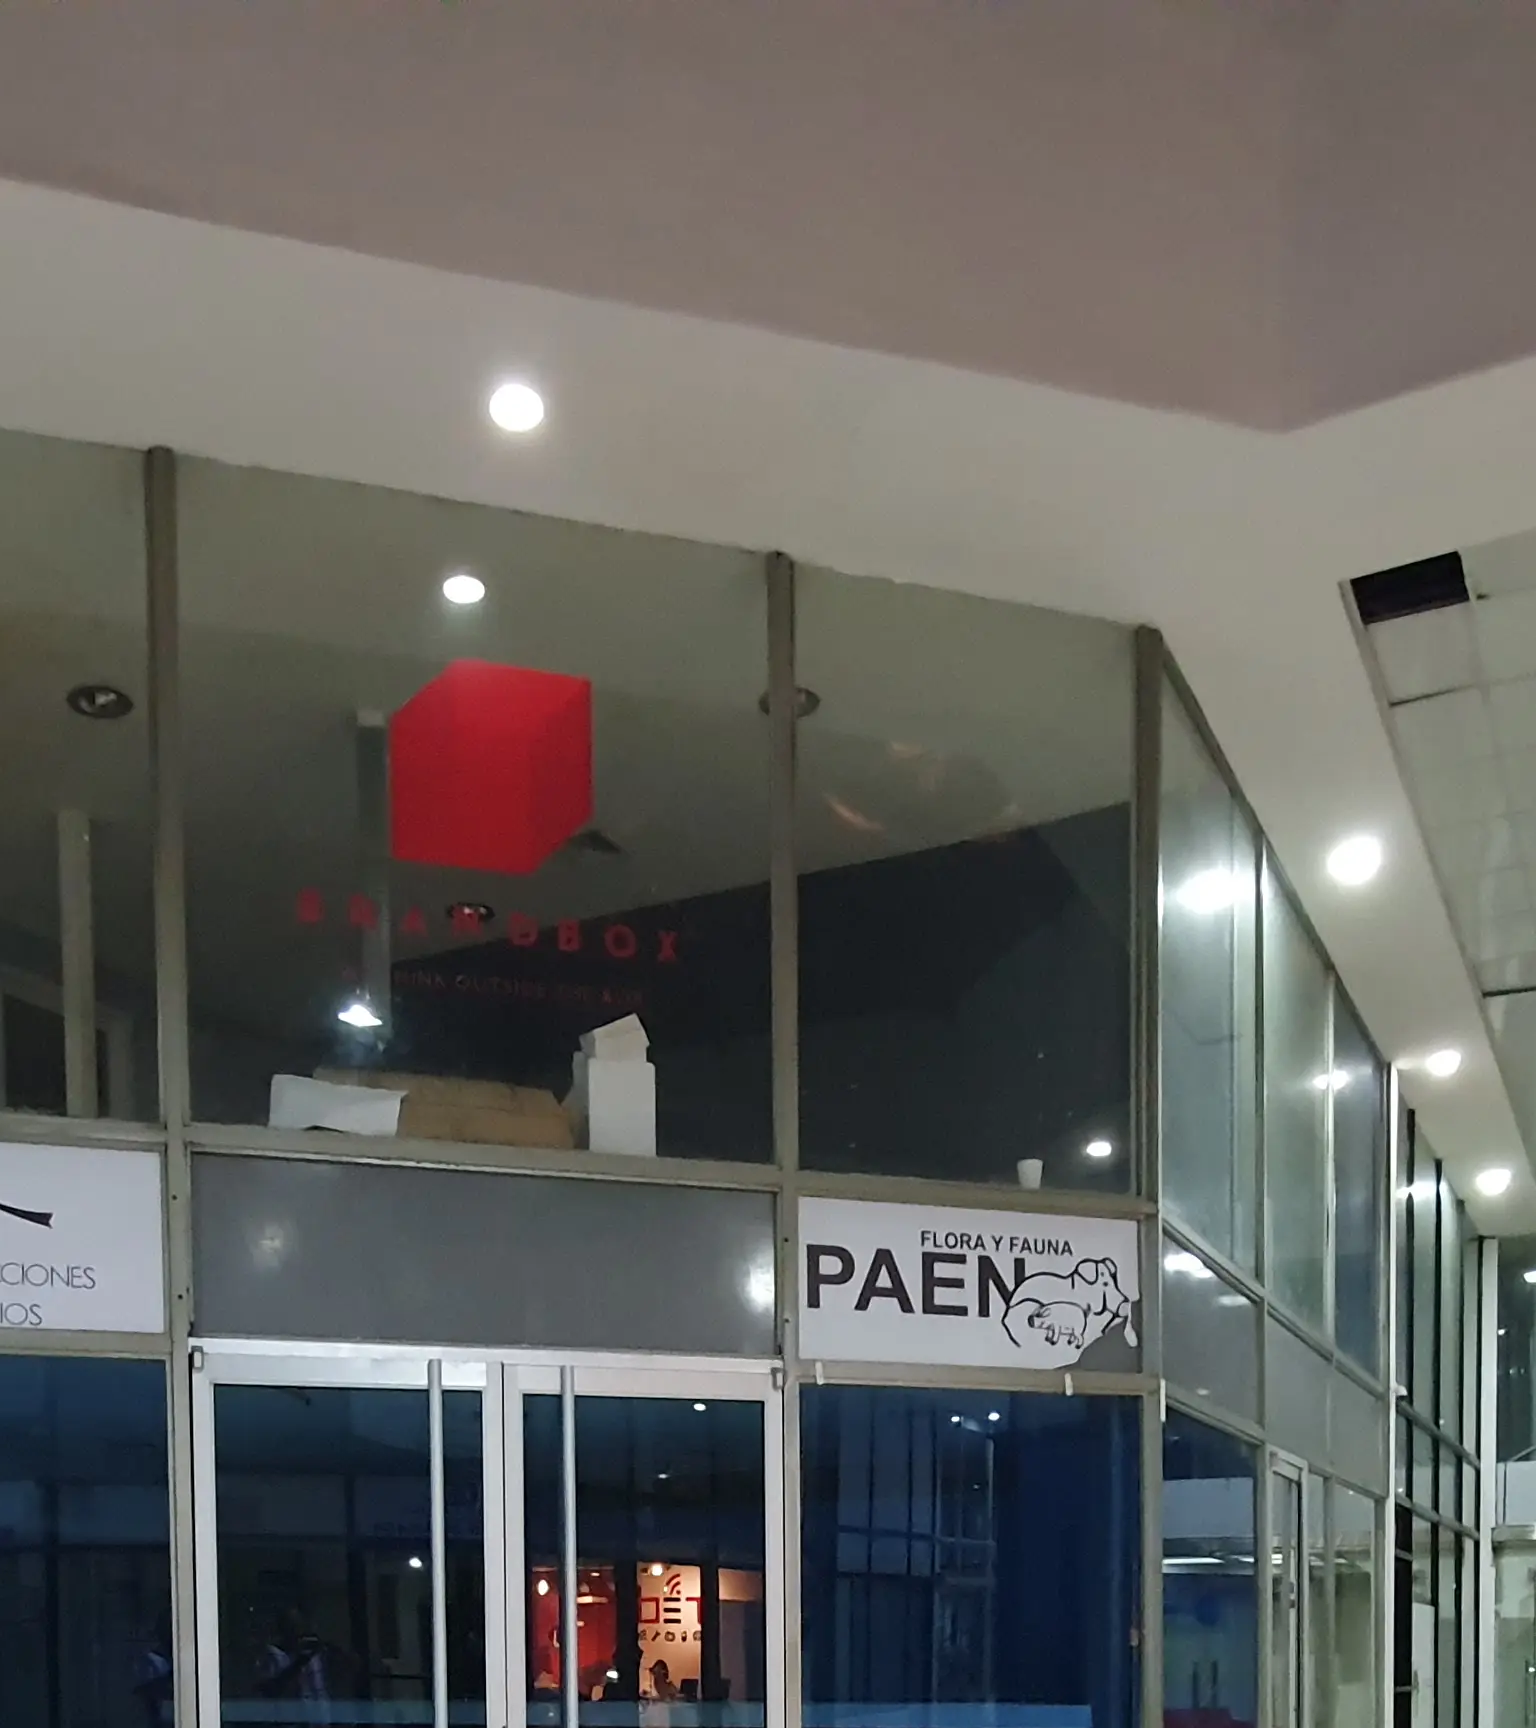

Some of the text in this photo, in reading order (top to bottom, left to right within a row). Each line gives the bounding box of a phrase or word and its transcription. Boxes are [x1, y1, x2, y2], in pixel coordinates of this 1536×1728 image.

[920, 1229, 1074, 1257] FLORA Y FAUNA
[806, 1243, 1026, 1318] PAEN
